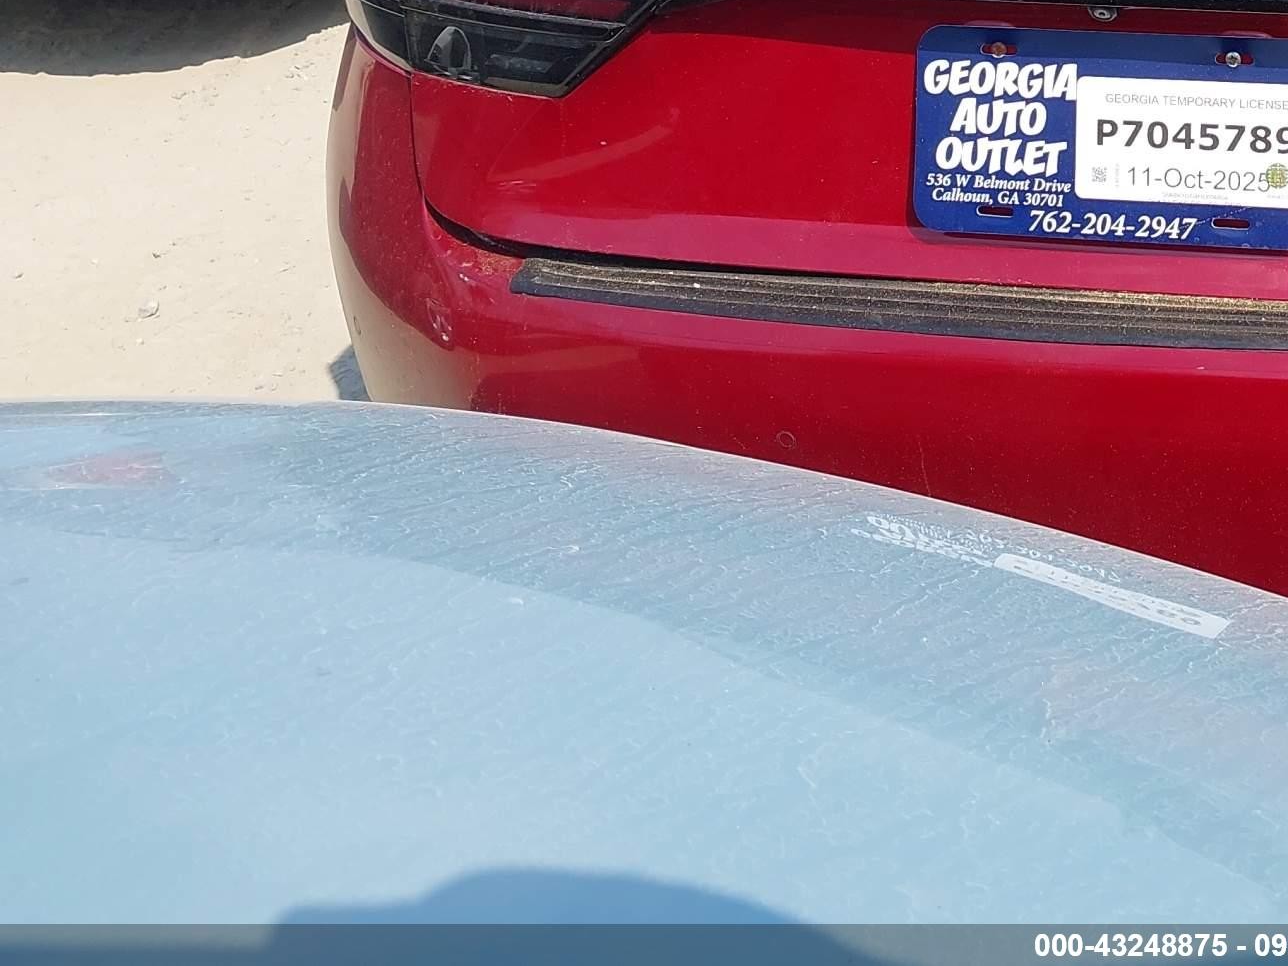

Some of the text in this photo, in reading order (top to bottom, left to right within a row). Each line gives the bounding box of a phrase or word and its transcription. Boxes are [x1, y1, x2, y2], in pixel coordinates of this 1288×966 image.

[923, 59, 1078, 100] GEORGIA
[1105, 93, 1288, 110] GEORGIA TEMPORARY LICENSE
[950, 99, 1047, 135] AUTO
[935, 136, 1067, 176] OUTLET
[926, 174, 1071, 193] 536 W Belmont Drive
[1127, 166, 1270, 193] 11-Oct-2025
[932, 188, 1064, 207] Calhoun, GA 30701
[1029, 209, 1198, 239] 762-204-2947
